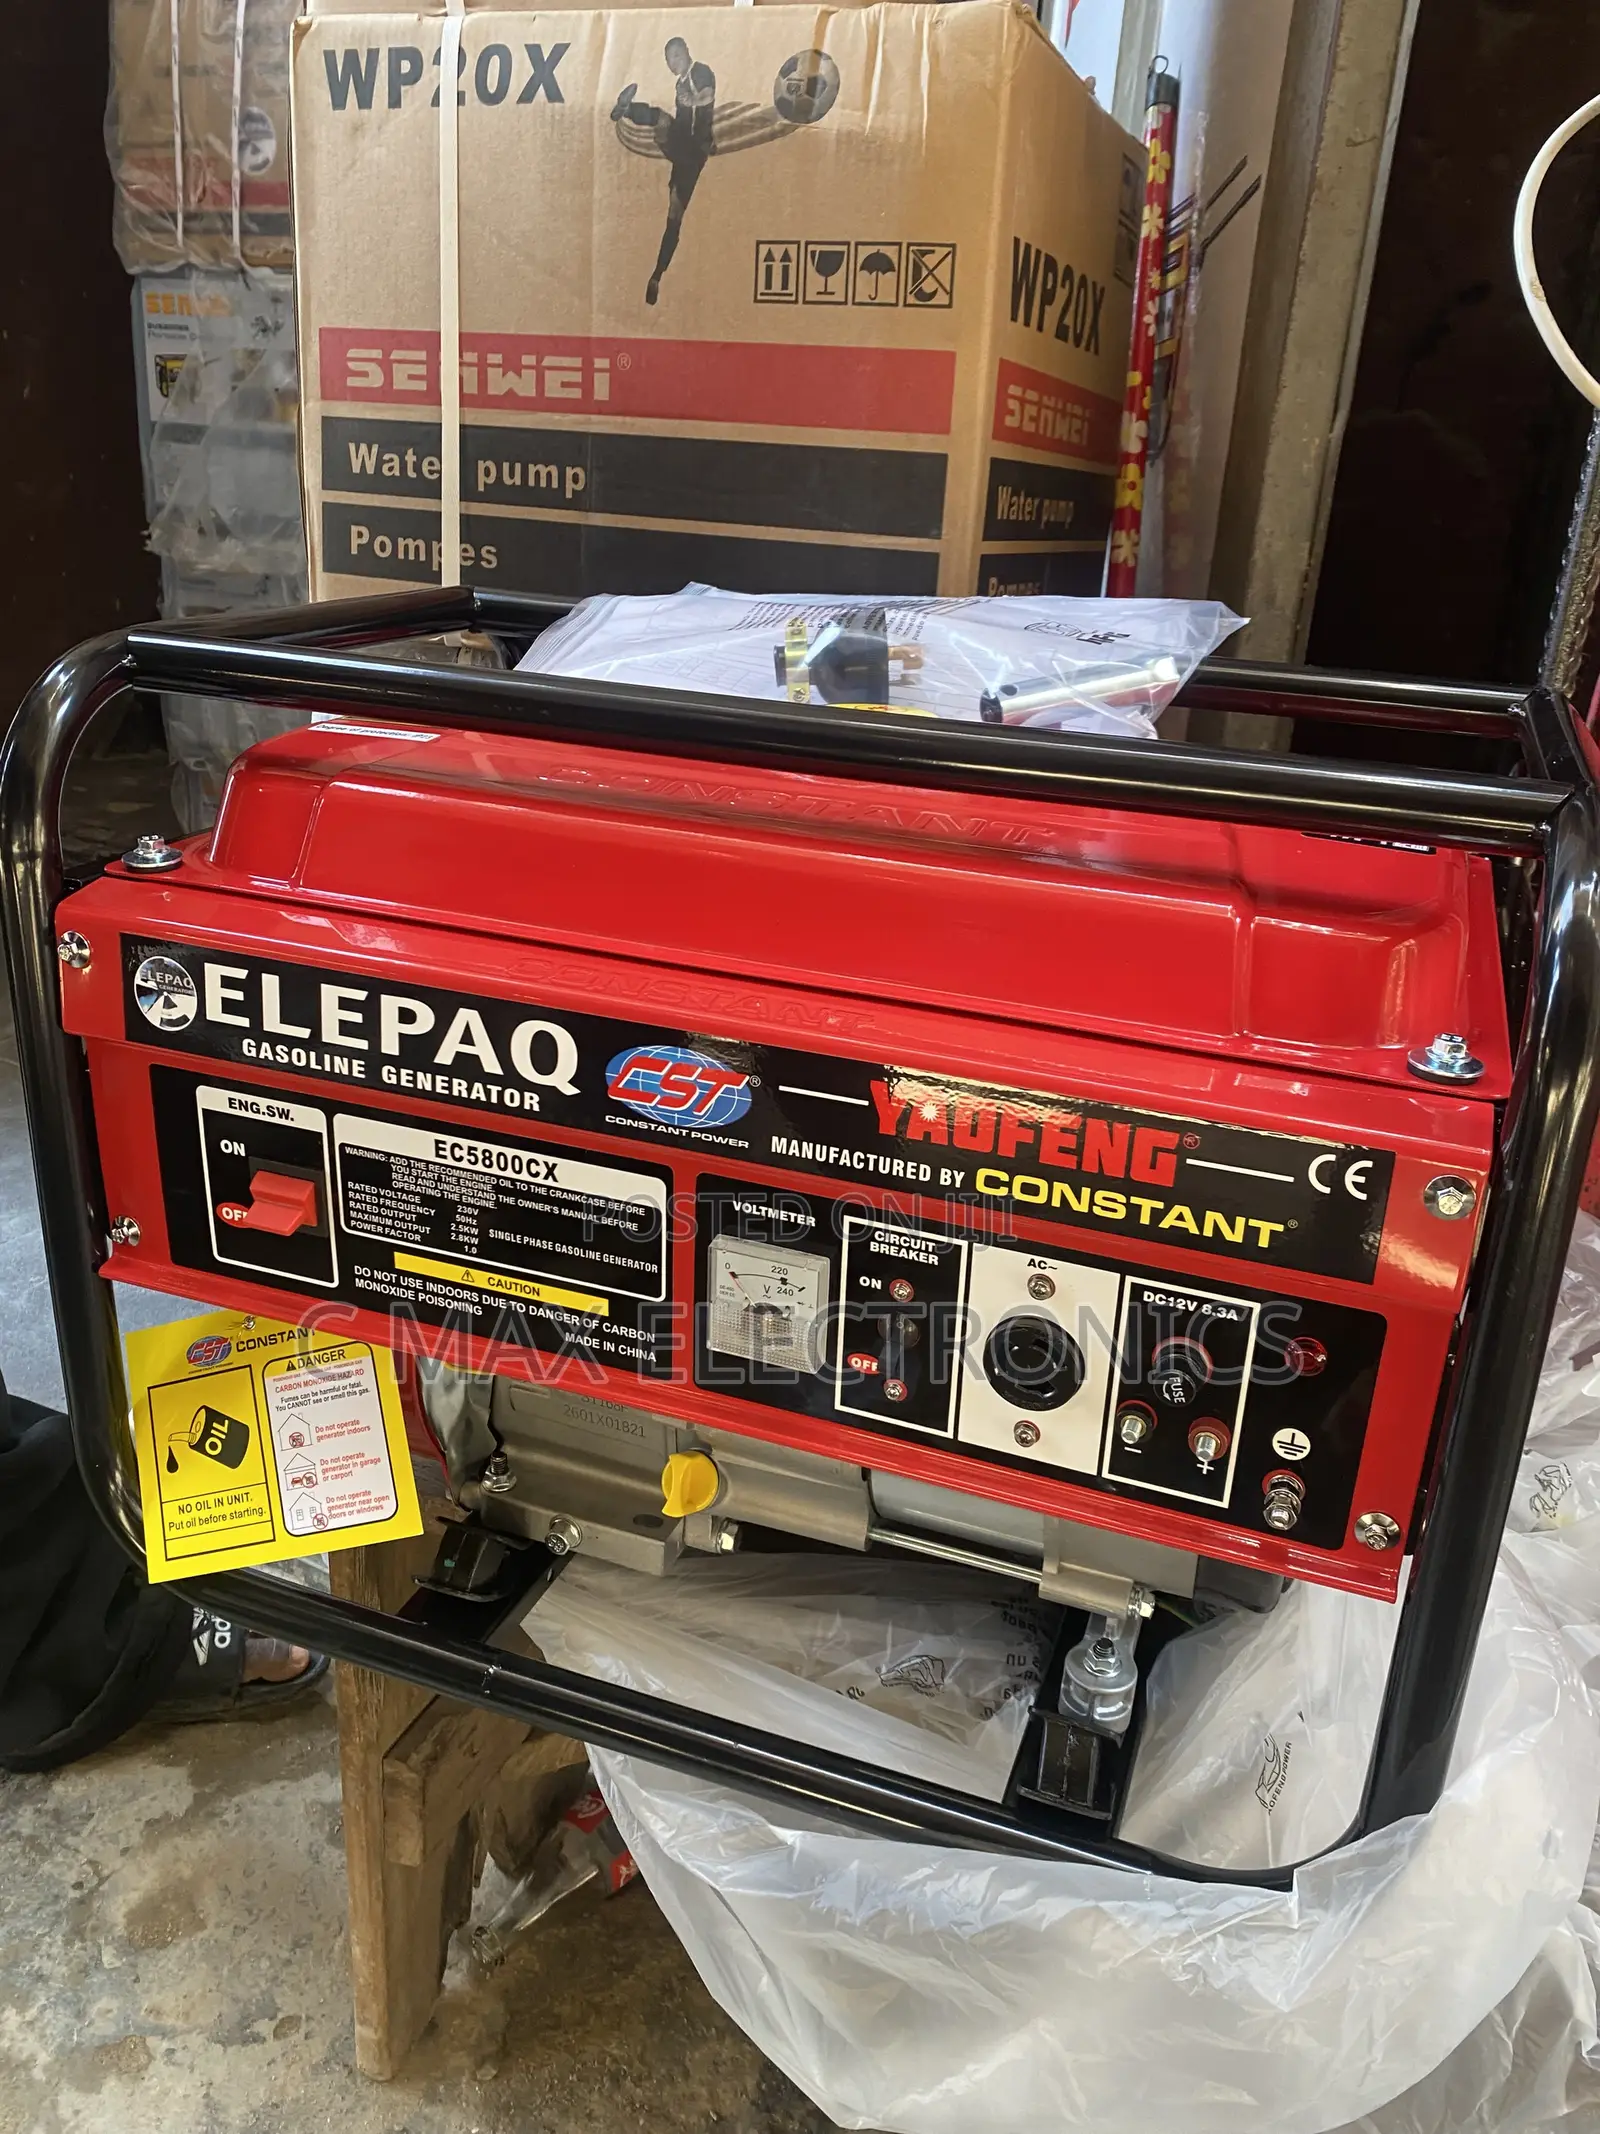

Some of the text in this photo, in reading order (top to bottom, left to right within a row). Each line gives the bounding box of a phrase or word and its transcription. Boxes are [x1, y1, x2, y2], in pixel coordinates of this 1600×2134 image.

[323, 43, 571, 111] WP20X
[1011, 236, 1105, 356] WP20X
[348, 442, 586, 499] Wate pump
[997, 485, 1075, 529] Water pump
[204, 961, 582, 1097] ELEPAQ
[241, 1038, 541, 1112] GASOLINE GENERATOR
[607, 1055, 750, 1116] CST
[227, 1096, 295, 1122] ENG.SW.
[604, 1114, 750, 1149] CONSTANT POWER
[219, 1138, 246, 1157] ON
[433, 1138, 559, 1183] EC5800CX
[344, 1146, 646, 1216] WARNING: ADD THE RECOMMENDED OIL TO THE CRANKCASE BEFORE
[391, 1164, 496, 1193] YOU START THE ENGINE.
[1307, 1152, 1374, 1201] CE
[347, 1181, 480, 1216] RATED VOLTAGE 230V
[391, 1180, 498, 1210] OPERATING THE ENGINE.
[391, 1172, 640, 1232] READ AND UNDERSTAND THE OWNER'S MANUAL BEFORE
[770, 1135, 1285, 1249] MANUFACTURED BY CONSTANT
[348, 1191, 478, 1226] RATED FREQUENCY 50Hz
[349, 1201, 480, 1236] RATED OUTPUT 2.5KW
[732, 1200, 817, 1228] VOLTMETER
[349, 1210, 480, 1246] MAXIMUM OUTPUT 2.8KW
[350, 1219, 478, 1255] POWER FACTOR 1.0
[874, 1230, 937, 1253] CIRCUIT
[488, 1228, 659, 1274] SINGLE PHASE GASOLINE GENERATOR
[869, 1241, 940, 1267] BREAKER
[770, 1264, 789, 1277] 220
[858, 1275, 883, 1291] ON
[354, 1277, 483, 1317] MONOXIDE POISONING
[487, 1276, 541, 1298] CAUTION
[776, 1286, 795, 1298] 240
[353, 1265, 656, 1344] DO NOT USE INDOORS DUE TO DANGER OF CARBON
[1143, 1290, 1240, 1321] DC12V 8.3A
[297, 1348, 346, 1369] DANGER
[565, 1331, 658, 1363] MADE IN CHINA
[275, 1381, 302, 1394] CARBON
[303, 1374, 336, 1389] MONOXIDE
[337, 1368, 365, 1383] HAZARD
[280, 1394, 299, 1404] Fumes
[311, 1390, 318, 1398] be
[319, 1386, 340, 1396] harmful
[348, 1381, 363, 1390] fatal.
[1169, 1375, 1186, 1404] FUSE
[275, 1404, 286, 1412] You
[287, 1400, 311, 1411] CANNOT
[330, 1392, 345, 1401] smell
[346, 1389, 357, 1397] this
[358, 1387, 370, 1397] gas.
[204, 1419, 229, 1456] OIL
[314, 1419, 360, 1434] Do not operate
[316, 1425, 370, 1443] generator indoors
[319, 1452, 365, 1466] Do not operate
[321, 1457, 381, 1476] generator in garage
[330, 1470, 353, 1482] carport
[178, 1492, 254, 1515] NO OIL IN UNIT.
[325, 1489, 371, 1504] Do not operate
[326, 1494, 390, 1513] generator near open
[168, 1505, 267, 1532] Put oil before starting.
[327, 1511, 346, 1520] doors
[355, 1503, 384, 1515] windows
